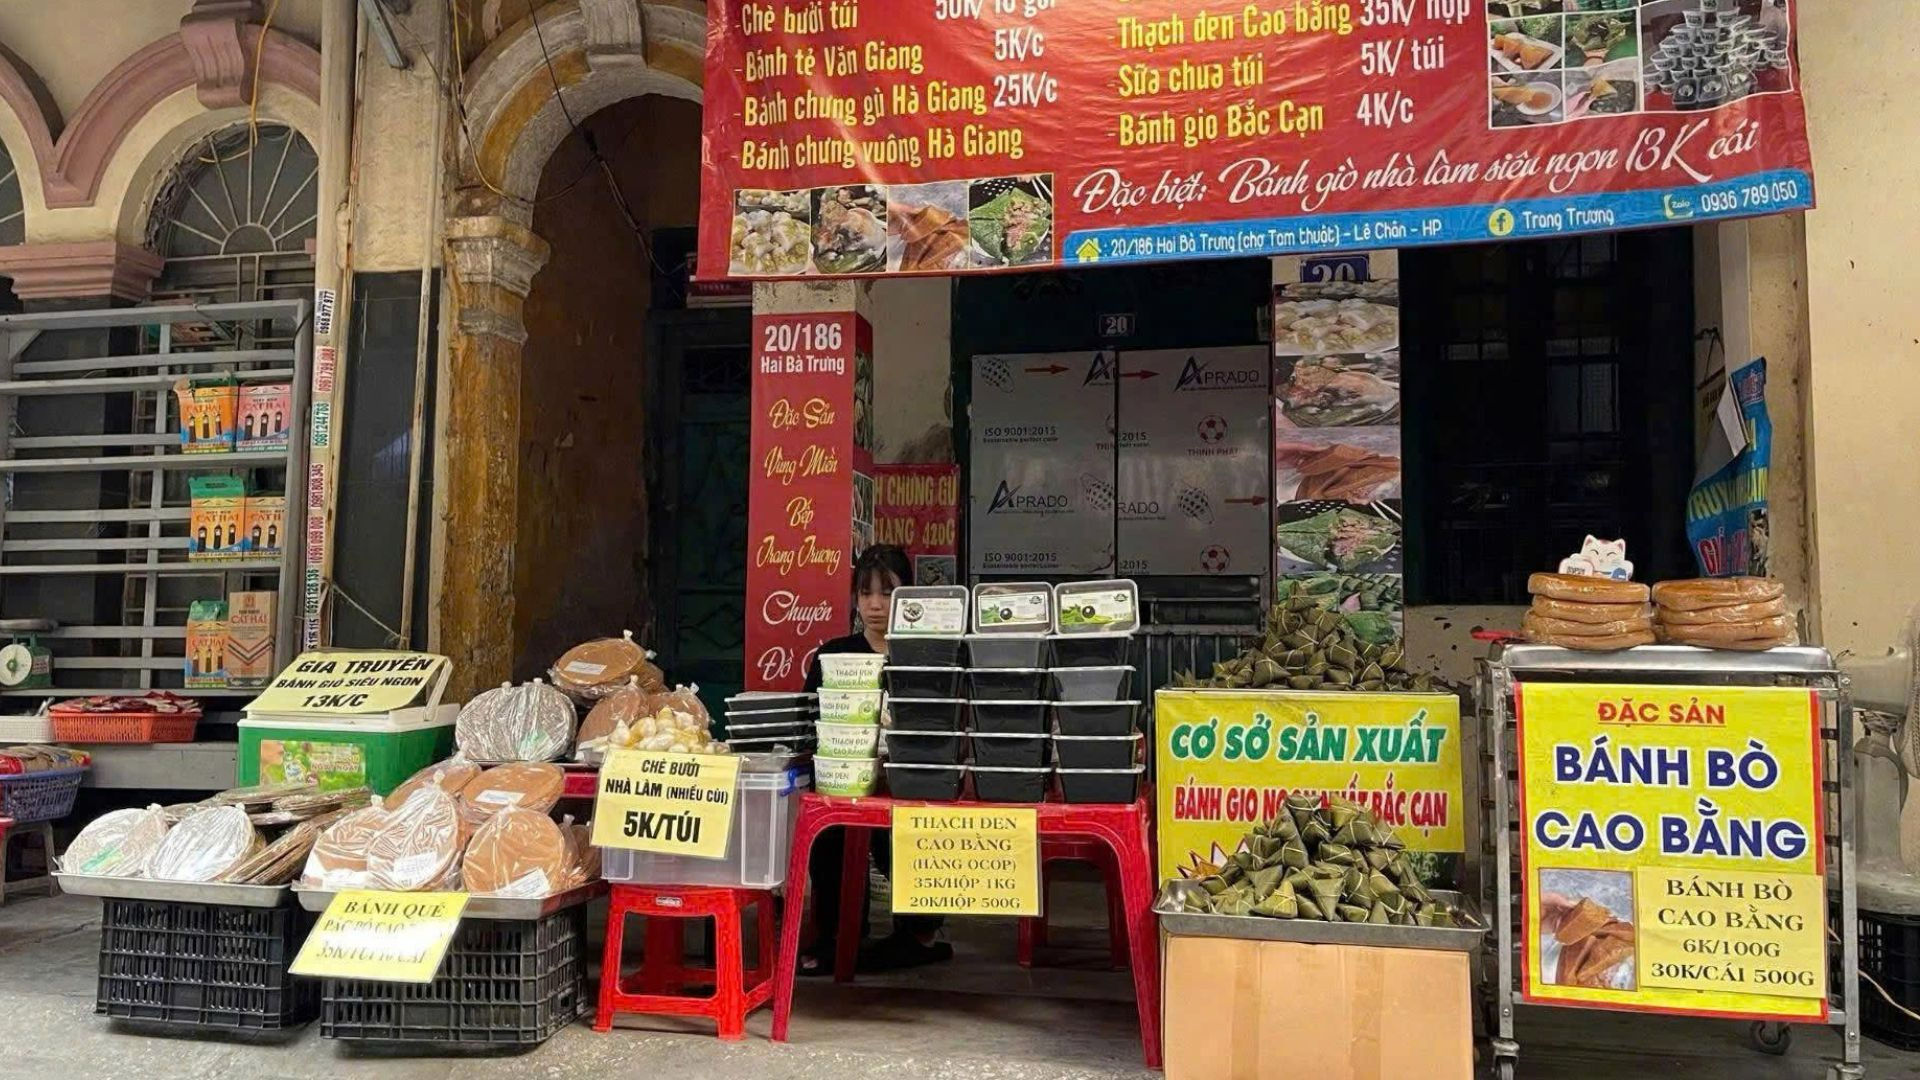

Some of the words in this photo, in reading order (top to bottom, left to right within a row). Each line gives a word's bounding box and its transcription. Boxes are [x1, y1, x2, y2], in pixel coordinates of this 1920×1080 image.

[742, 3, 775, 36] Chè
[784, 1, 824, 34] bưởi
[830, 0, 858, 30] túi
[1117, 13, 1184, 52] Thạch
[1194, 10, 1234, 43] đen
[1243, 4, 1286, 38] Cao
[995, 26, 1044, 62] 5K/c
[1361, 38, 1404, 77] 5K/
[1411, 35, 1445, 70] túi
[746, 46, 787, 82] Bánh
[824, 46, 858, 77] Văn
[865, 41, 924, 75] Giang
[1119, 63, 1160, 97] Sữa
[1169, 59, 1223, 93] chua
[1232, 53, 1264, 87] túi
[745, 91, 787, 126] Bánh
[794, 89, 857, 126] chưng
[863, 87, 885, 126] gù
[892, 84, 919, 115] Hà
[927, 80, 987, 115] Giang
[993, 71, 1058, 107] 25K/c
[1357, 91, 1414, 128] 4K/c
[1120, 111, 1176, 146] Bánh
[1184, 107, 1218, 148] gio
[1227, 99, 1270, 138] Bắc
[1279, 99, 1323, 138] Cạn
[742, 139, 790, 170] Bánh
[795, 134, 856, 169] chưng
[863, 133, 922, 168] vuông
[928, 127, 955, 159] Hà
[963, 124, 1024, 160] Giang
[1072, 167, 1147, 214] Đặc
[1151, 169, 1208, 211] biệt:
[1218, 157, 1310, 204] Bánh
[1301, 156, 1358, 212] giò
[1362, 151, 1419, 190] nhà
[1484, 151, 1541, 182] siêu
[1545, 147, 1619, 194] ngon
[1625, 117, 1713, 183] 13K
[1709, 121, 1760, 160] cái
[1701, 191, 1736, 212] 0936
[1741, 185, 1768, 207] 789
[1772, 180, 1798, 202] 050
[1523, 209, 1562, 231] Trang
[1111, 238, 1153, 257] 20/186
[1156, 237, 1176, 255] Hai
[1180, 231, 1196, 251] Bà
[1354, 222, 1371, 241] Lê
[1375, 220, 1407, 240] Chân
[1422, 219, 1442, 236] HP
[765, 322, 842, 352] 20/186
[1105, 316, 1128, 335] 20
[761, 356, 782, 374] Hai
[786, 354, 803, 373] Bà
[806, 354, 845, 375] Trưng
[768, 398, 800, 430] Đặc
[803, 398, 835, 429] Sản
[984, 427, 1001, 437] ISO
[1004, 426, 1056, 437] 9001:2015
[764, 446, 797, 486] Vùng
[800, 445, 838, 477] Miền
[786, 496, 814, 530] Bếp
[757, 535, 795, 576] Trang
[984, 552, 1001, 562] ISO
[1004, 552, 1057, 562] 9001:2015
[762, 590, 833, 636] Chuyên
[296, 660, 338, 674] GIA
[757, 646, 794, 681] Đồ
[275, 677, 317, 689] BÁNH
[381, 676, 424, 687] NGON
[302, 693, 369, 708] 13K/C
[1598, 697, 1660, 728] ĐẶC
[1668, 697, 1725, 724] SẢN
[1170, 718, 1218, 760] CƠ
[1223, 713, 1272, 761] SỞ
[1277, 712, 1347, 762] SẢN
[1352, 709, 1446, 763] XUẤT
[641, 759, 666, 774] CHÈ
[1555, 735, 1689, 786] BÁNH
[1708, 739, 1778, 789] BÒ
[605, 777, 631, 795] NHÀ
[635, 779, 662, 798] LÀM
[1174, 776, 1222, 821] BÁNH
[1226, 786, 1258, 822] GIO
[1410, 790, 1448, 837] CẠN
[623, 810, 701, 844] 5K/TÚI
[910, 816, 973, 832] THẠCH
[1535, 811, 1644, 851] CAO
[1661, 798, 1806, 860] BẰNG
[916, 838, 954, 851] CAO
[961, 832, 1012, 851] BẰNG
[913, 856, 962, 873] (HÀNG
[968, 859, 1017, 872] OCOP)
[914, 875, 980, 891] 35K/HỘP
[986, 878, 1016, 889] 1KG
[1666, 875, 1744, 898] BÁNH
[1754, 879, 1793, 901] BÒ
[344, 898, 399, 915] BÁNH
[910, 894, 976, 910] 20K/HỘP
[981, 897, 1020, 909] 500G
[1658, 908, 1716, 927] CAO
[1726, 904, 1804, 932] BẰNG
[1683, 938, 1780, 958] 6K/100G
[1651, 962, 1745, 982] 30K/CÁI
[1754, 969, 1815, 986] 500G
